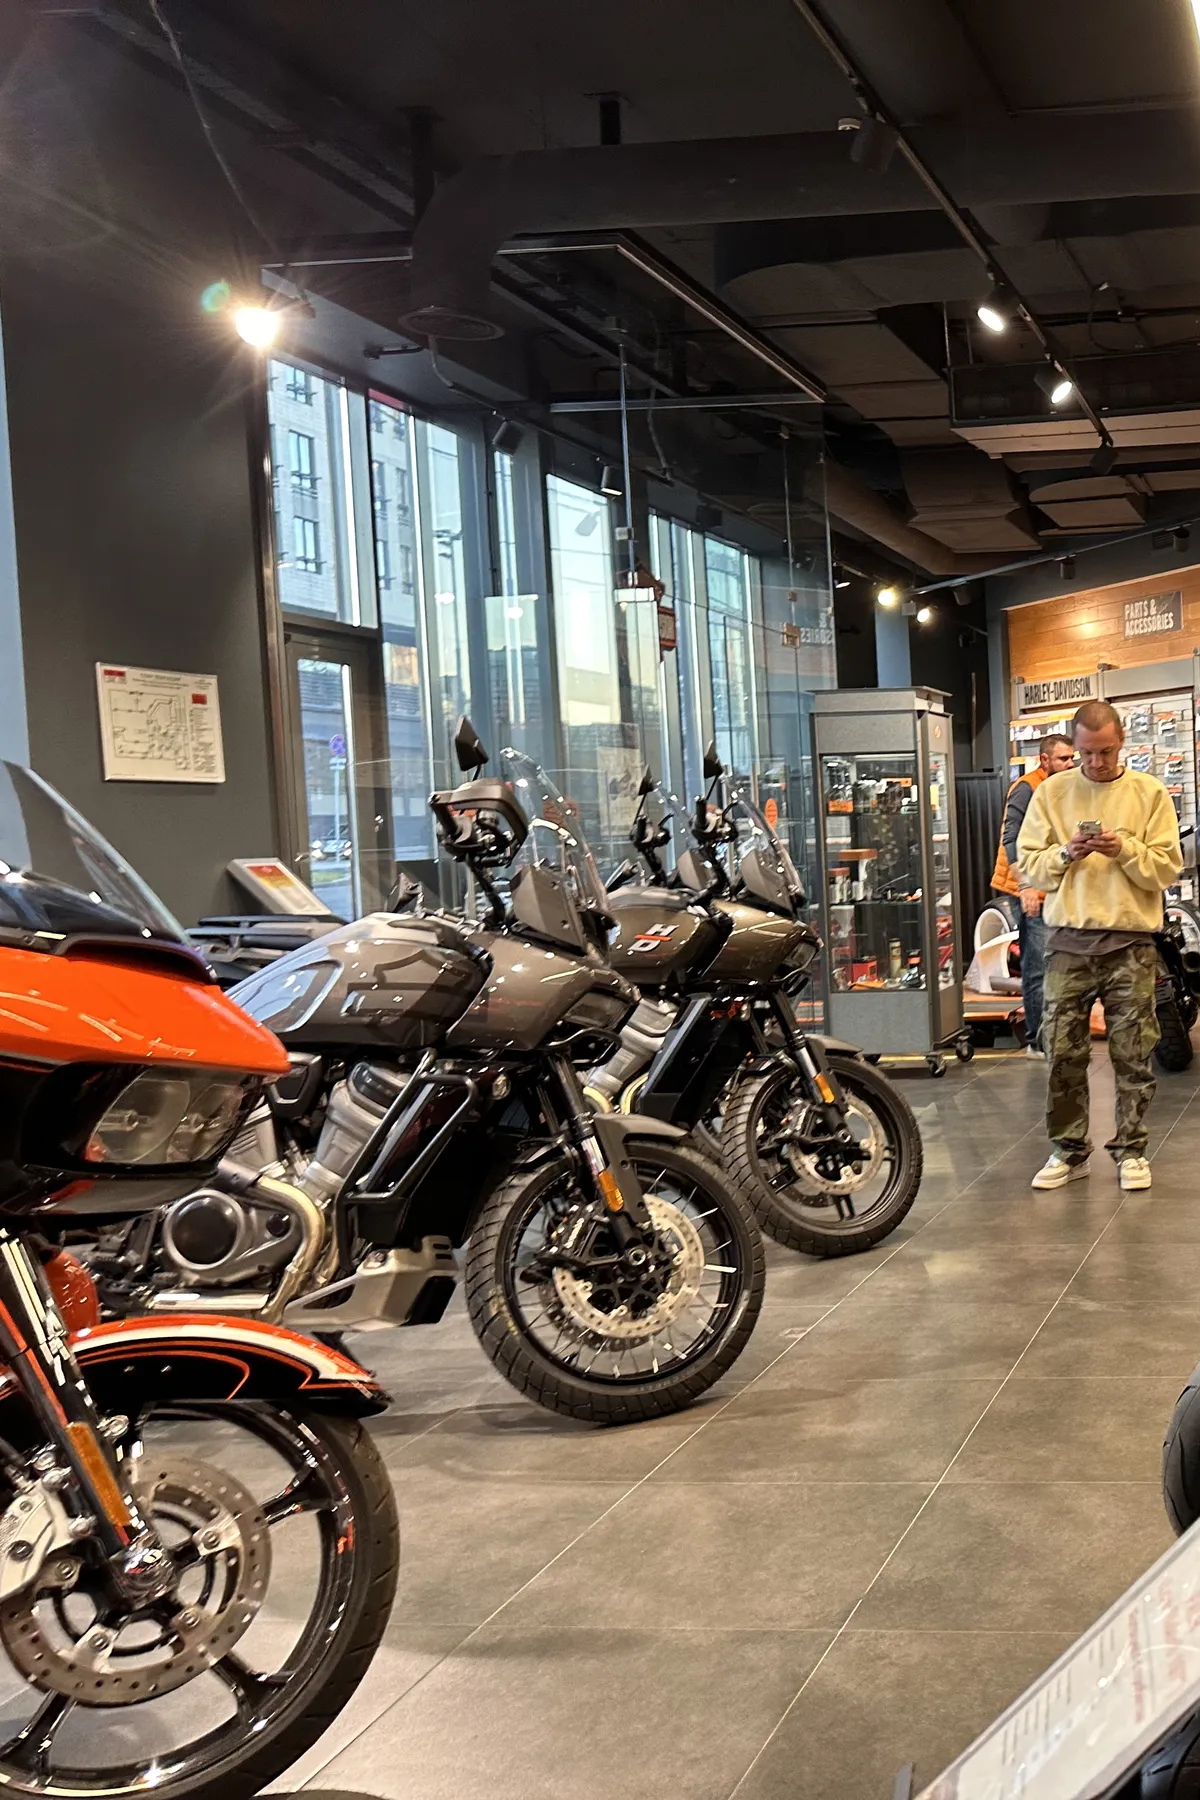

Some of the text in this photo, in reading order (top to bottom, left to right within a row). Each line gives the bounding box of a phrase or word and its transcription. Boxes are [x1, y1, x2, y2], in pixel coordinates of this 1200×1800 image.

[1125, 599, 1157, 621] PARTS &
[1125, 612, 1174, 637] ACCESSORIES
[1024, 676, 1091, 705] HARLEY-DAVIDSON
